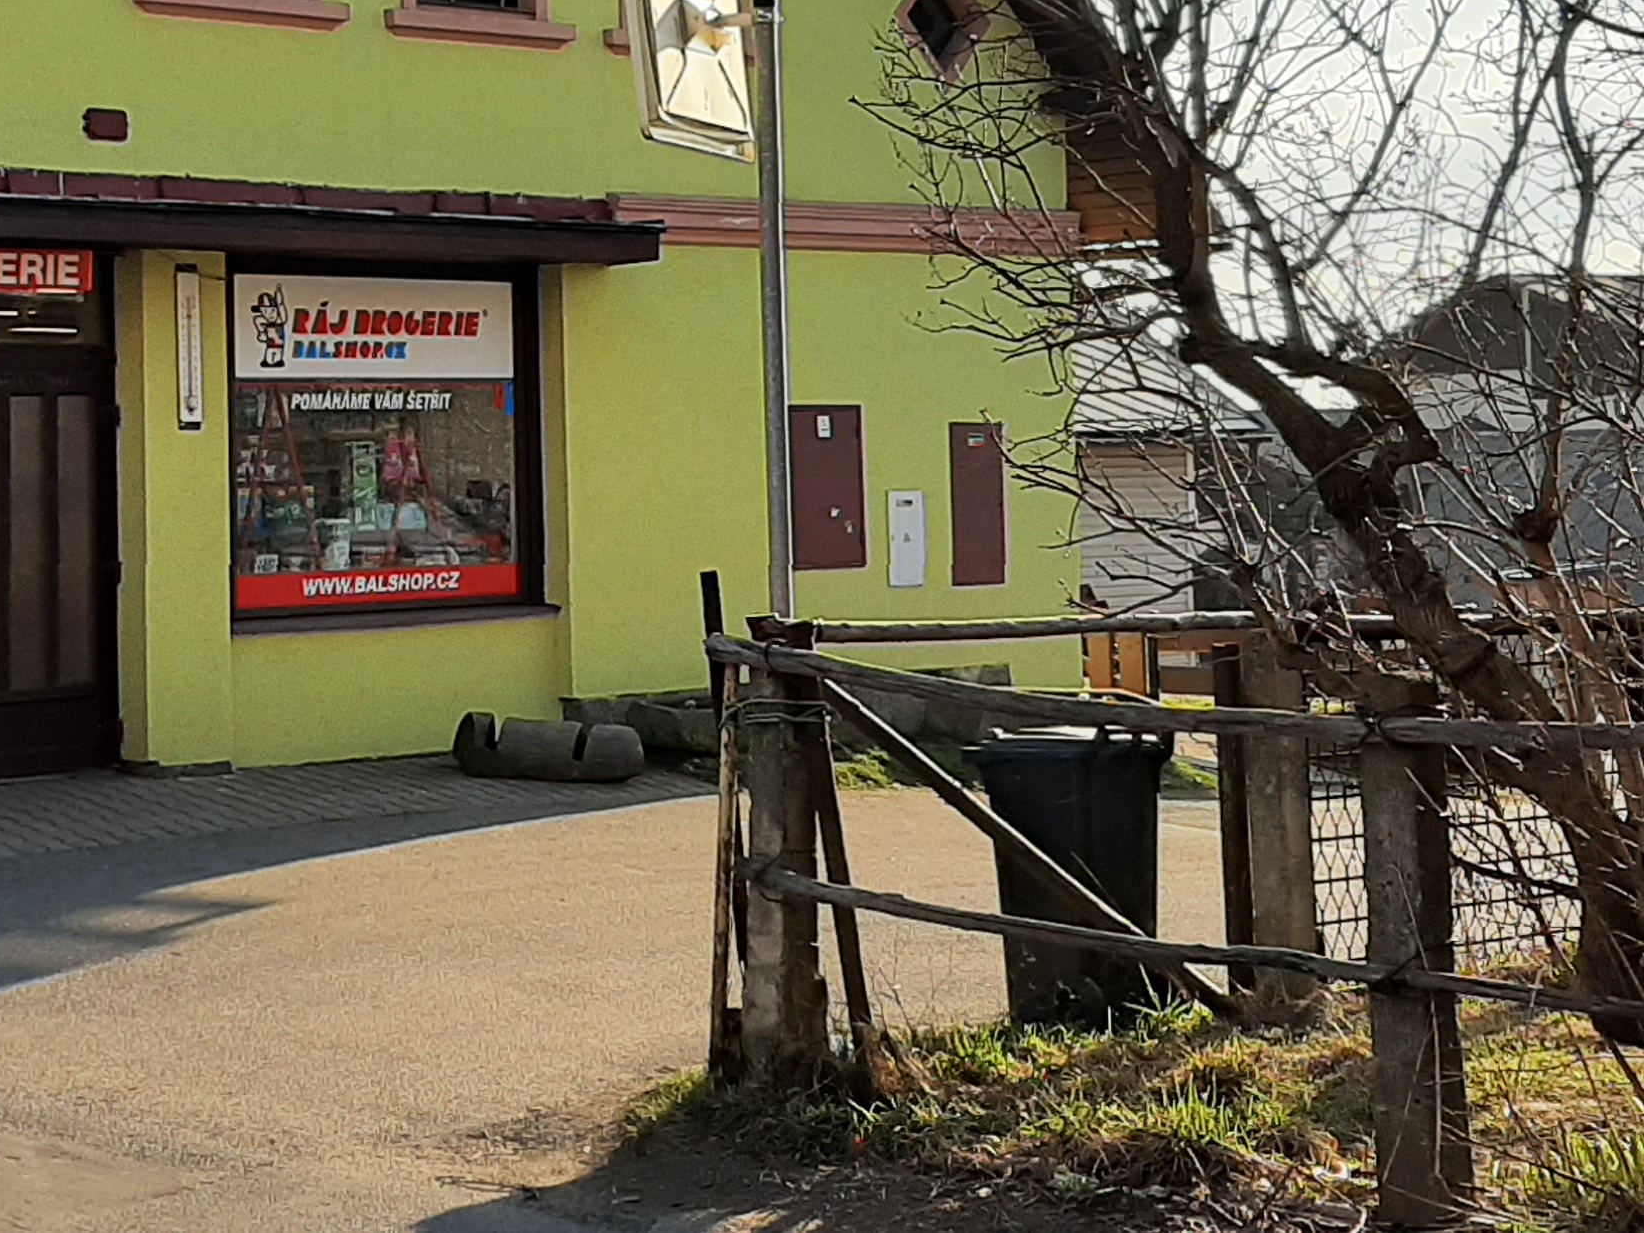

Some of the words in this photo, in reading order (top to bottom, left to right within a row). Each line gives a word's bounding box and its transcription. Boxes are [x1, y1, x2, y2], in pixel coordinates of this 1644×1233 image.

[292, 301, 349, 335] RÁJ
[353, 309, 481, 337] DROGERIE
[292, 340, 408, 359] BALSHOP.CZ
[290, 389, 372, 410] POMÁHÁME
[374, 390, 403, 410] VÁM
[302, 571, 461, 596] WWW.BALSHOP.CZ
